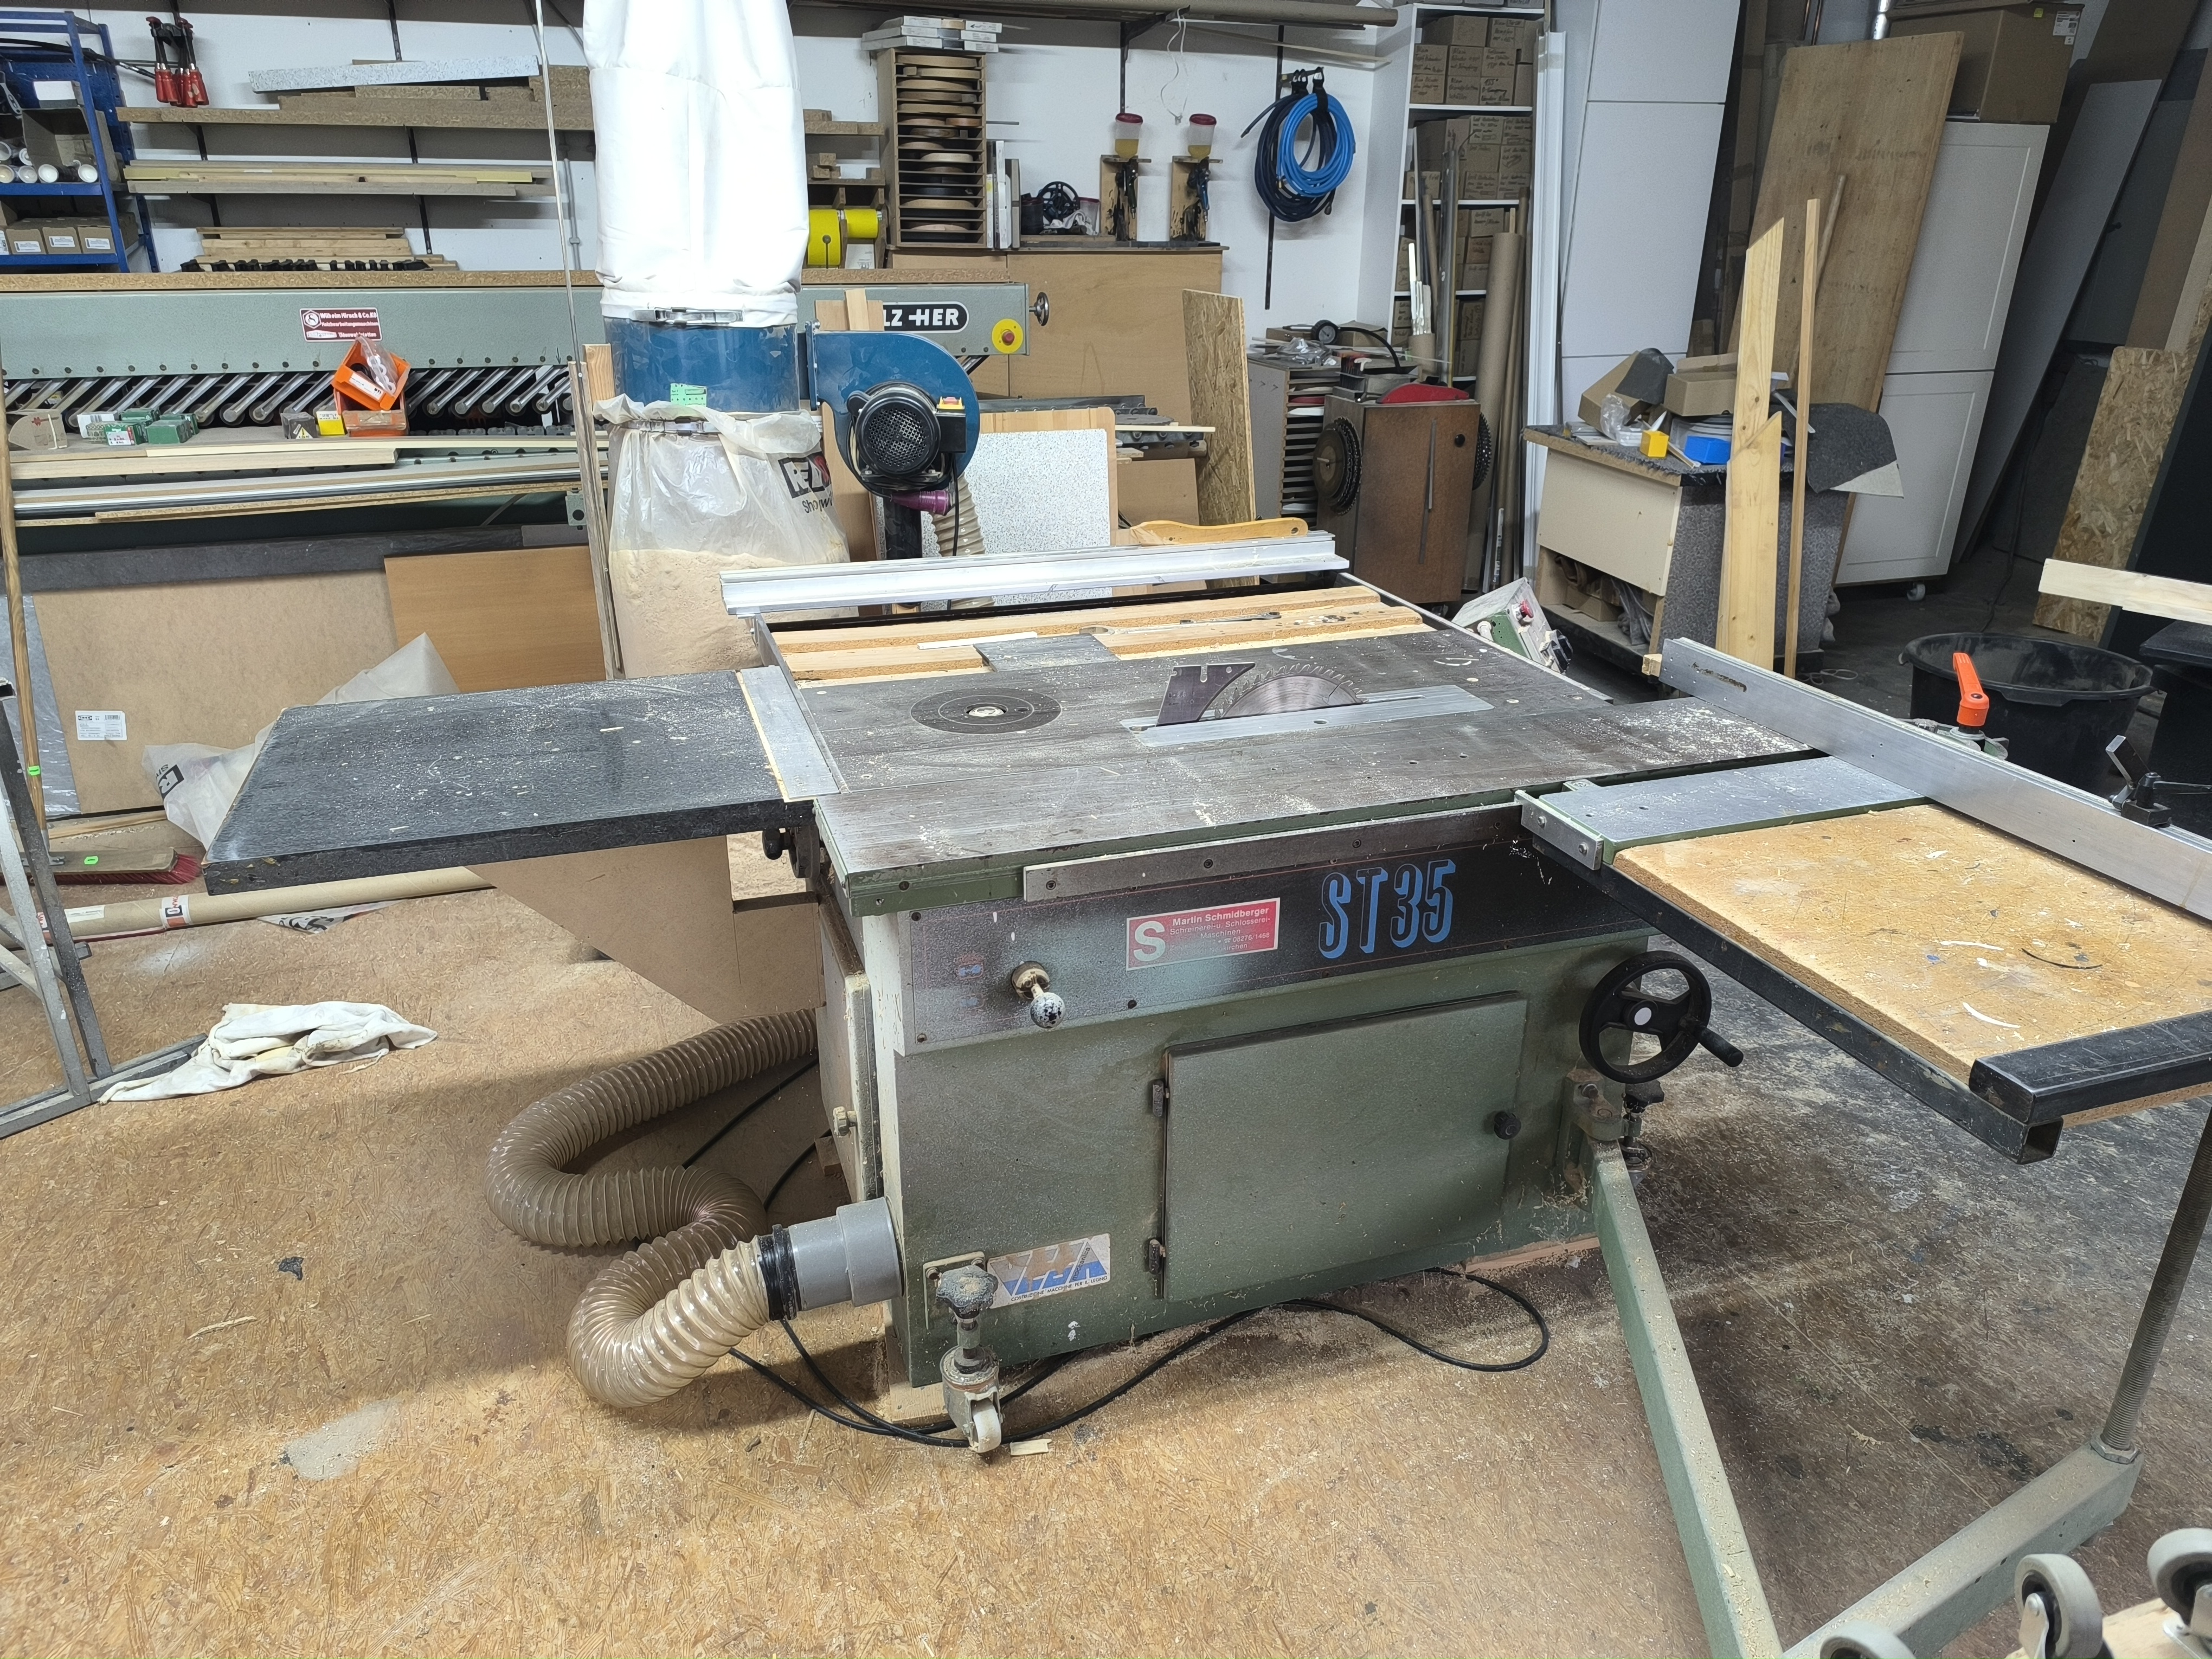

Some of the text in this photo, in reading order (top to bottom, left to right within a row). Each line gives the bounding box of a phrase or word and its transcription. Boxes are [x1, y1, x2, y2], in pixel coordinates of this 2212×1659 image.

[1173, 908, 1269, 926] Martin Schmidberger
[1200, 929, 1240, 938] Maschinen
[1233, 933, 1270, 942] 08276/1468
[1133, 921, 1166, 962] S
[1047, 1284, 1072, 1293] MACCHNE
